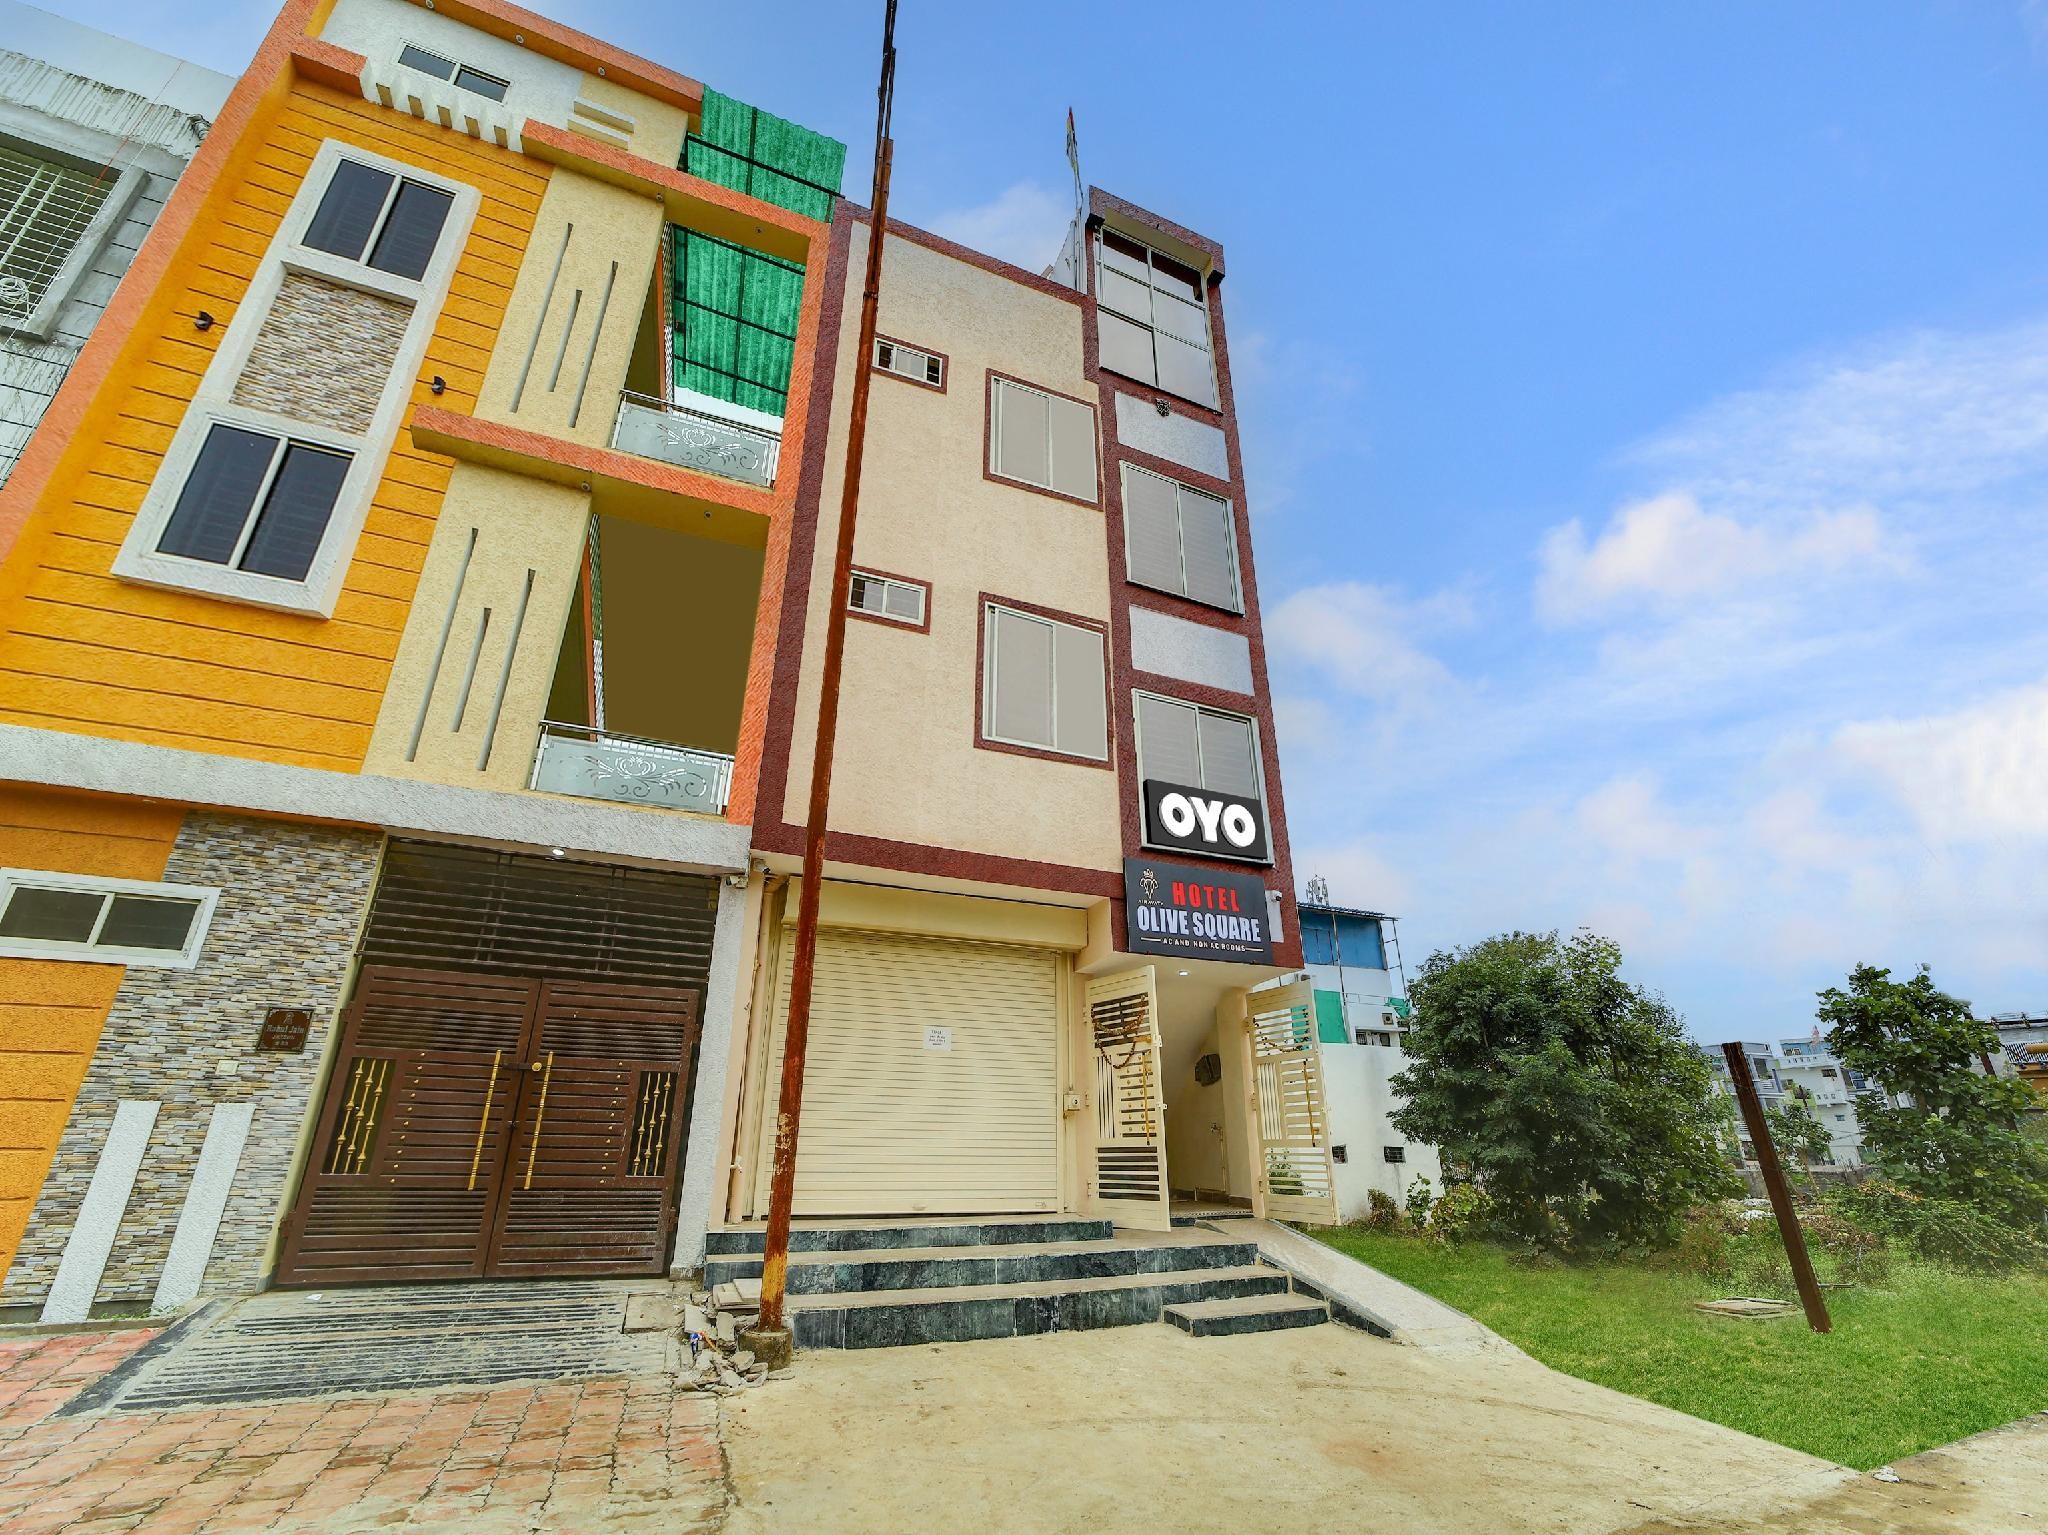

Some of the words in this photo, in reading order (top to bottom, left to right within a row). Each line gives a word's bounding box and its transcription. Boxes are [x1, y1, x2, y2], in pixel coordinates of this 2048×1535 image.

[1159, 793, 1256, 848] OYO
[1172, 881, 1240, 912] HOTEL
[1137, 905, 1190, 935] OLIVE
[1193, 911, 1262, 943] SQUARE
[1174, 938, 1190, 946] AND
[1193, 940, 1208, 948] NON
[1221, 943, 1246, 952] ROOMS
